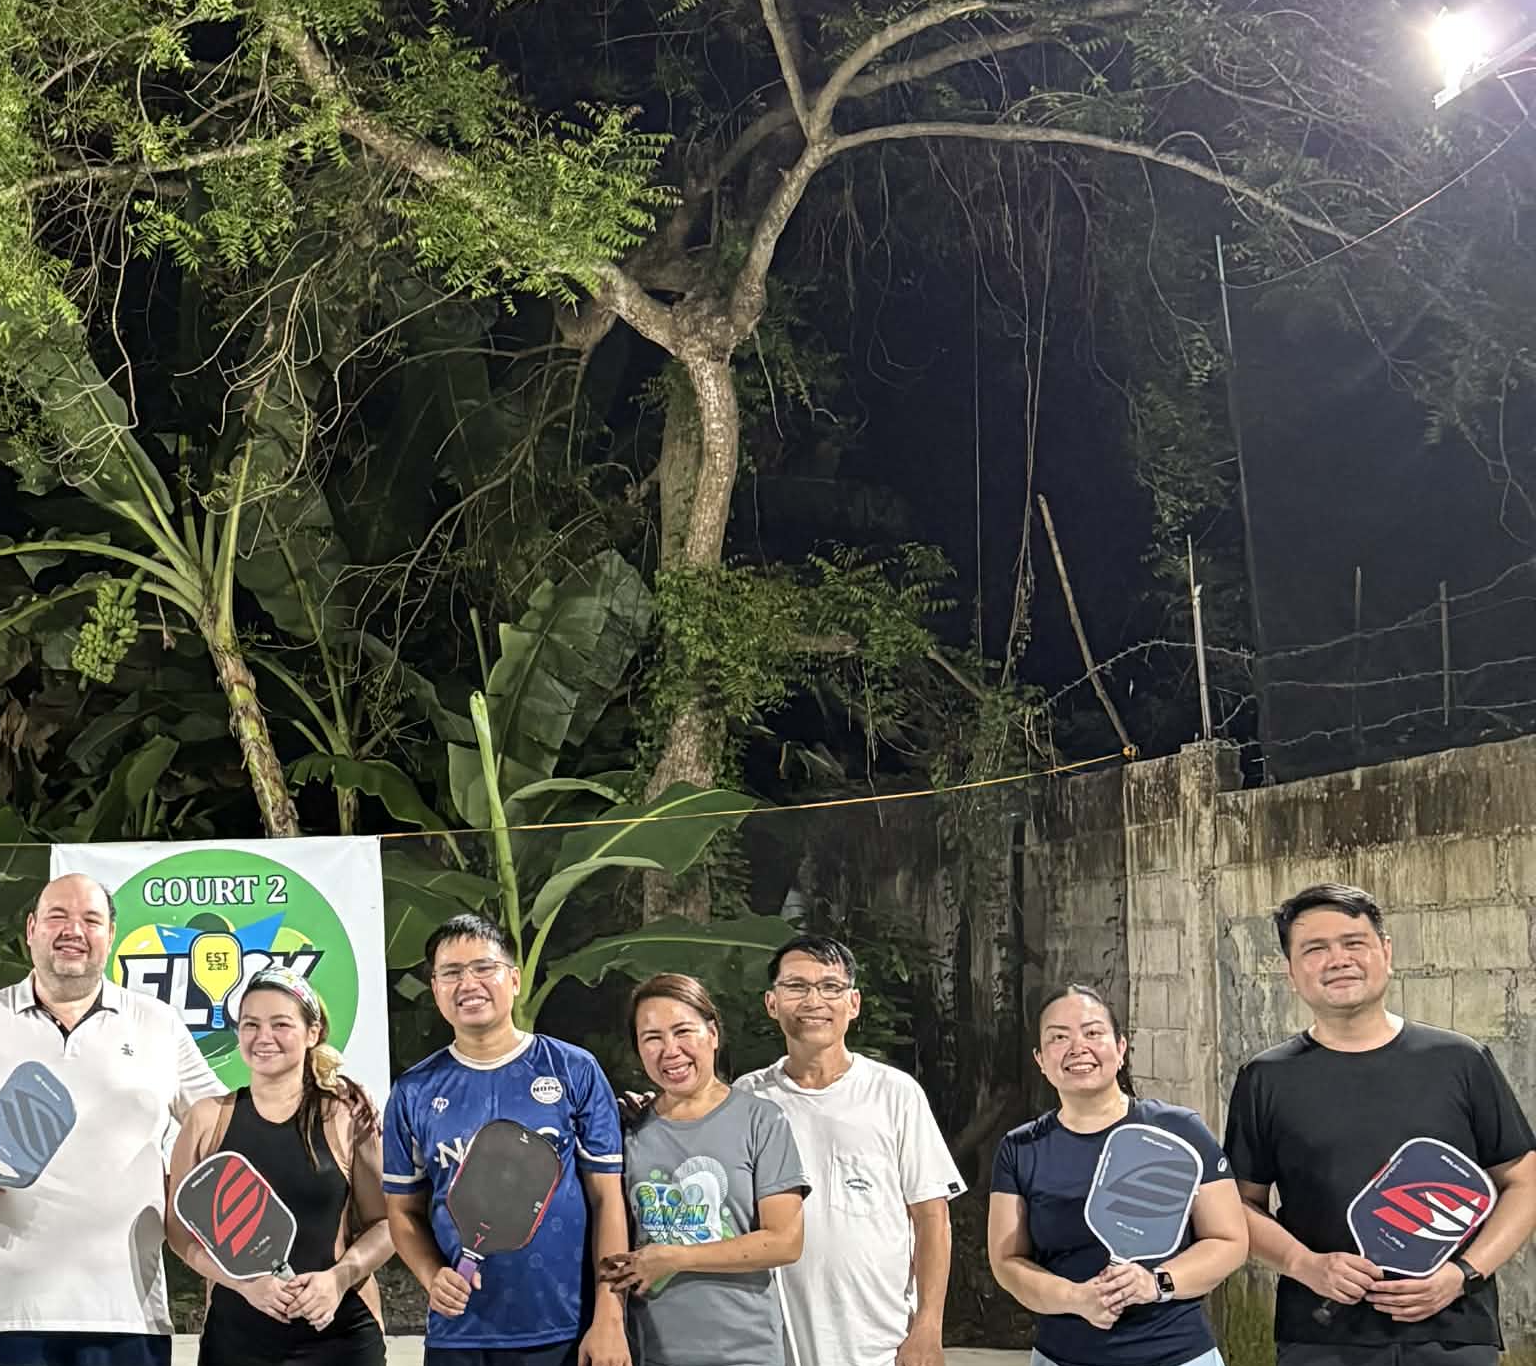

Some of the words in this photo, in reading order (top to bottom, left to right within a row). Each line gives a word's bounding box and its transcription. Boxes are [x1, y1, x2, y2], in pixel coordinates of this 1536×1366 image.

[143, 875, 260, 906] COURT
[266, 875, 287, 903] 2
[206, 951, 229, 962] EST
